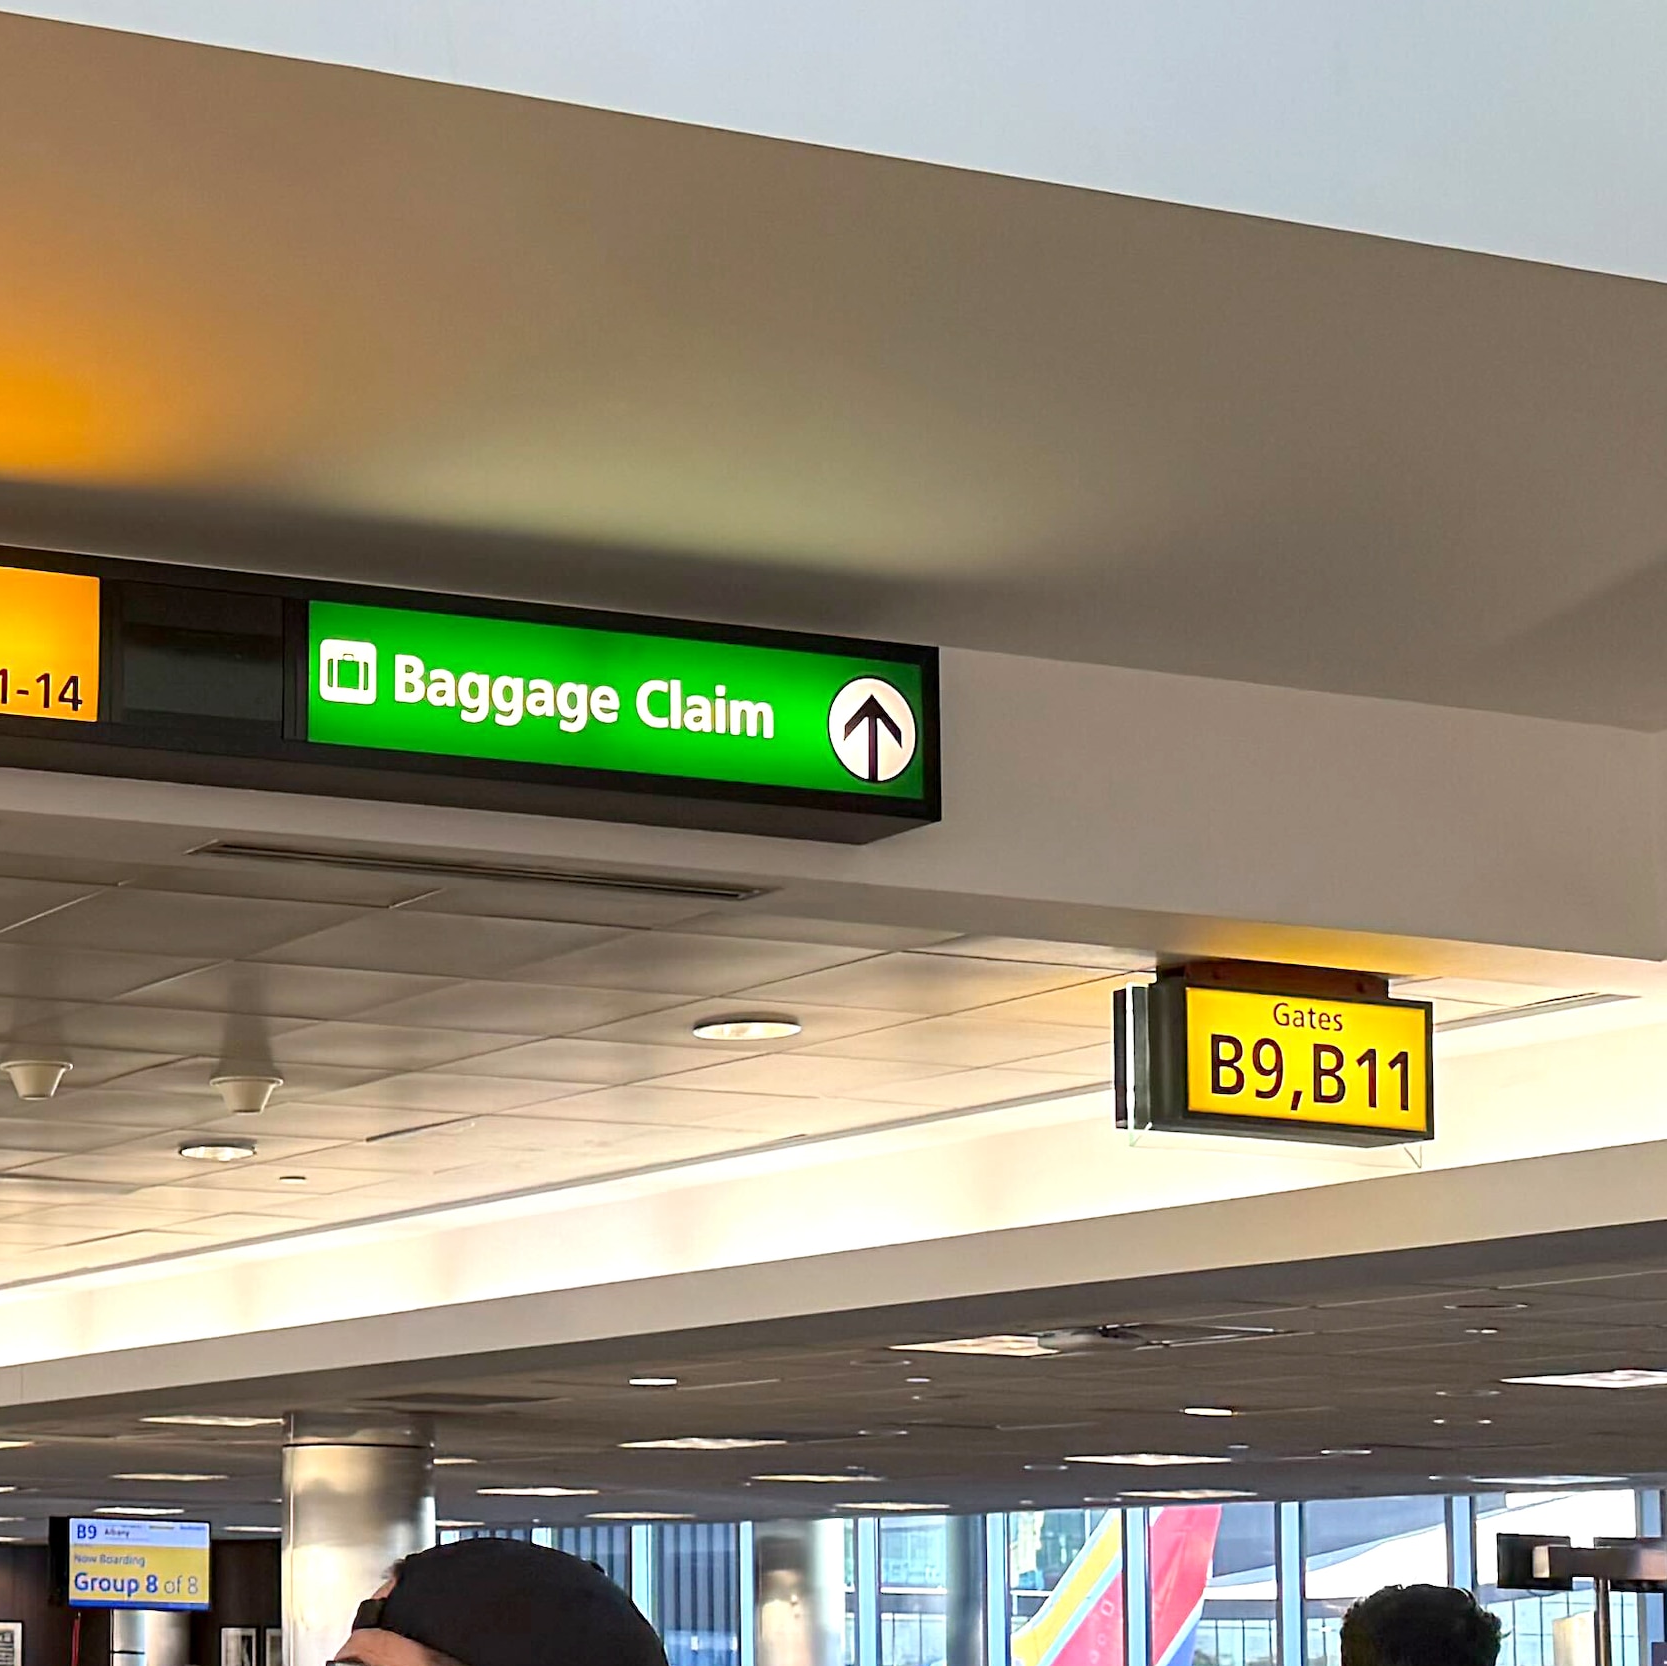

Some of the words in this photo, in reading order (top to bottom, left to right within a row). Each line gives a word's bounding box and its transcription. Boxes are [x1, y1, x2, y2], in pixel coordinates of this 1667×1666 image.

[393, 653, 621, 733] Baggage
[635, 678, 776, 739] Claim
[1272, 1001, 1344, 1032] Gates
[1210, 1033, 1410, 1112] B9,B11
[76, 1524, 97, 1540] B9
[73, 1553, 97, 1564] Now
[99, 1554, 146, 1567] Boarding
[74, 1572, 140, 1597] Group
[145, 1574, 159, 1594] 8
[163, 1576, 183, 1594] of
[187, 1576, 199, 1595] 8
